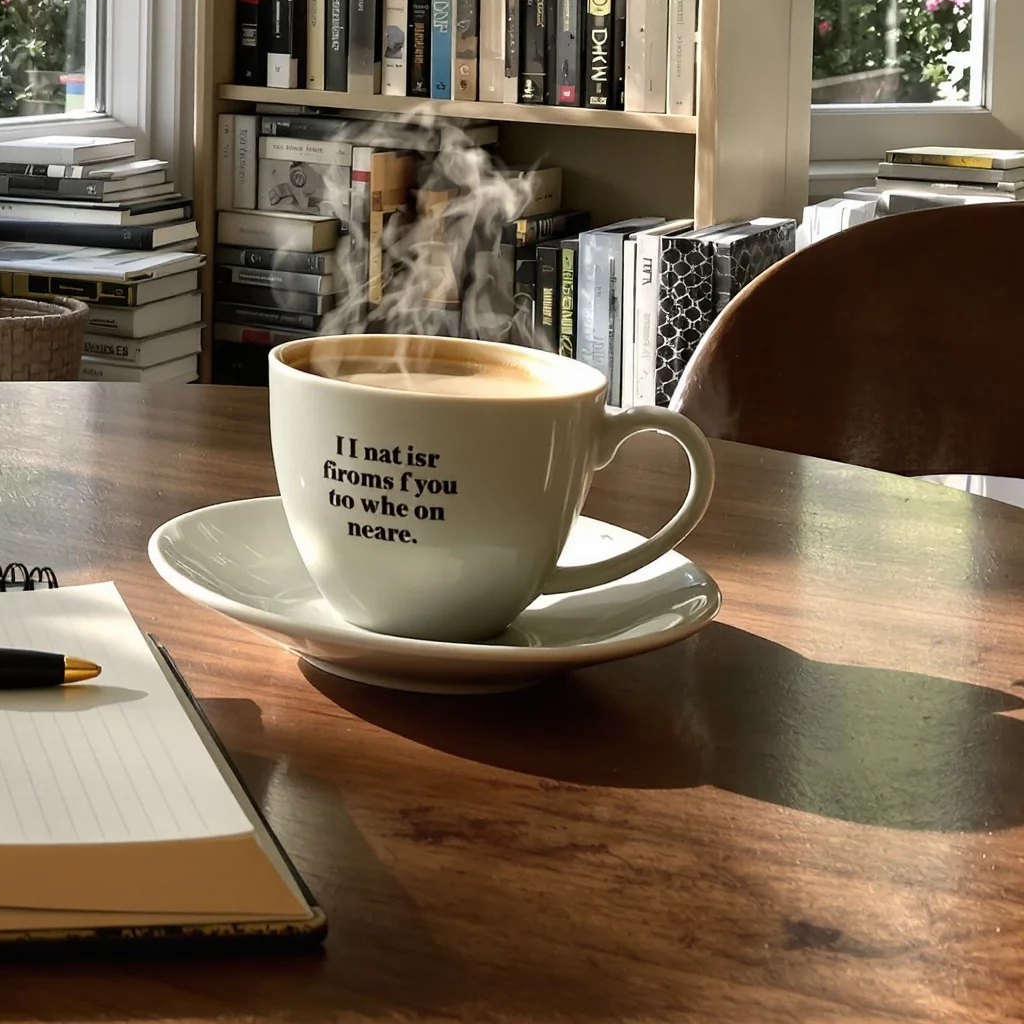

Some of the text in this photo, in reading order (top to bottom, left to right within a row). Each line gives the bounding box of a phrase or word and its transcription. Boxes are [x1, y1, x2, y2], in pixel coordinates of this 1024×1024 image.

[364, 446, 402, 465] nat
[407, 445, 440, 468] isr
[347, 521, 417, 544] neare.
